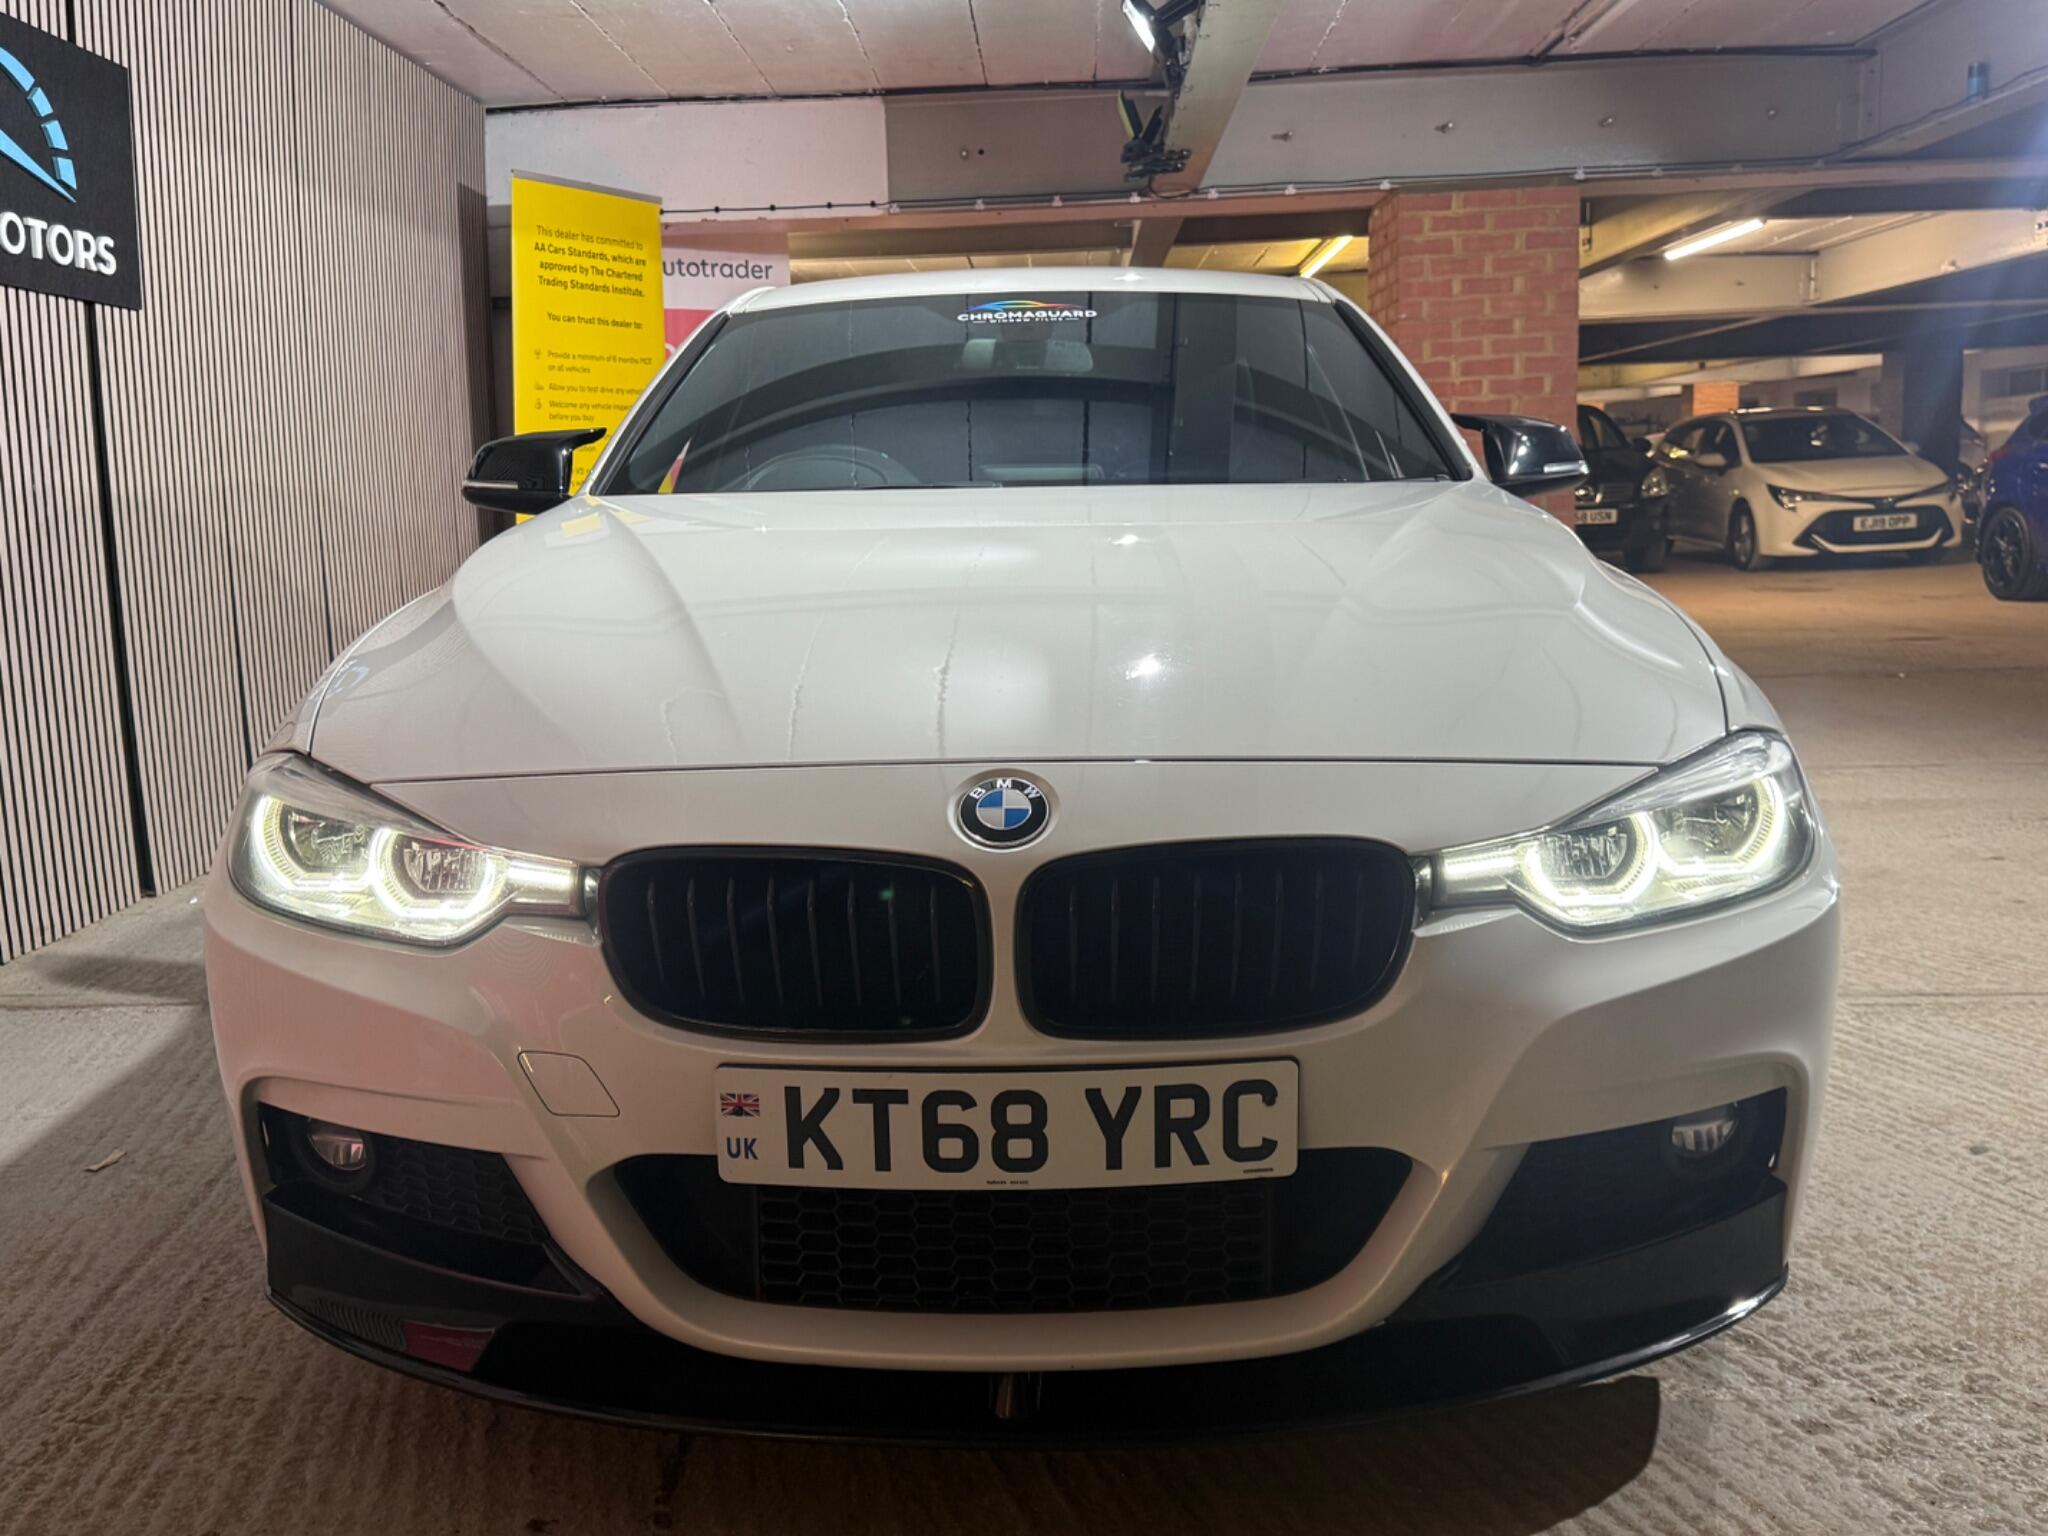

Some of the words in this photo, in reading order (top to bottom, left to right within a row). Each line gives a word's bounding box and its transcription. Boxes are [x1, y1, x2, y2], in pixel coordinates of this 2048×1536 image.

[536, 225, 552, 237] This
[554, 229, 580, 240] dealer
[581, 232, 594, 243] has
[596, 235, 635, 249] committed
[635, 241, 643, 250] to
[534, 242, 546, 252] AA
[547, 244, 566, 255] Cars
[567, 246, 610, 262] Standards,
[612, 254, 633, 264] which
[634, 258, 646, 267] are
[539, 261, 577, 274] approved
[579, 264, 589, 276] by
[590, 265, 604, 276] The
[606, 268, 643, 281] Chartered
[662, 258, 773, 280] utotrader
[538, 275, 569, 290] Trading
[570, 279, 610, 293] Standards
[612, 285, 645, 297] Institute.
[547, 311, 561, 322] You
[562, 314, 576, 322] can
[577, 315, 596, 325] trust
[597, 316, 610, 326] this
[611, 318, 632, 328] dealer
[957, 310, 1098, 321] CHROMAGUARD
[969, 778, 1041, 799] BMW
[784, 1085, 1049, 1173] KT68
[1084, 1078, 1279, 1171] YRC
[725, 1137, 759, 1160] UK
